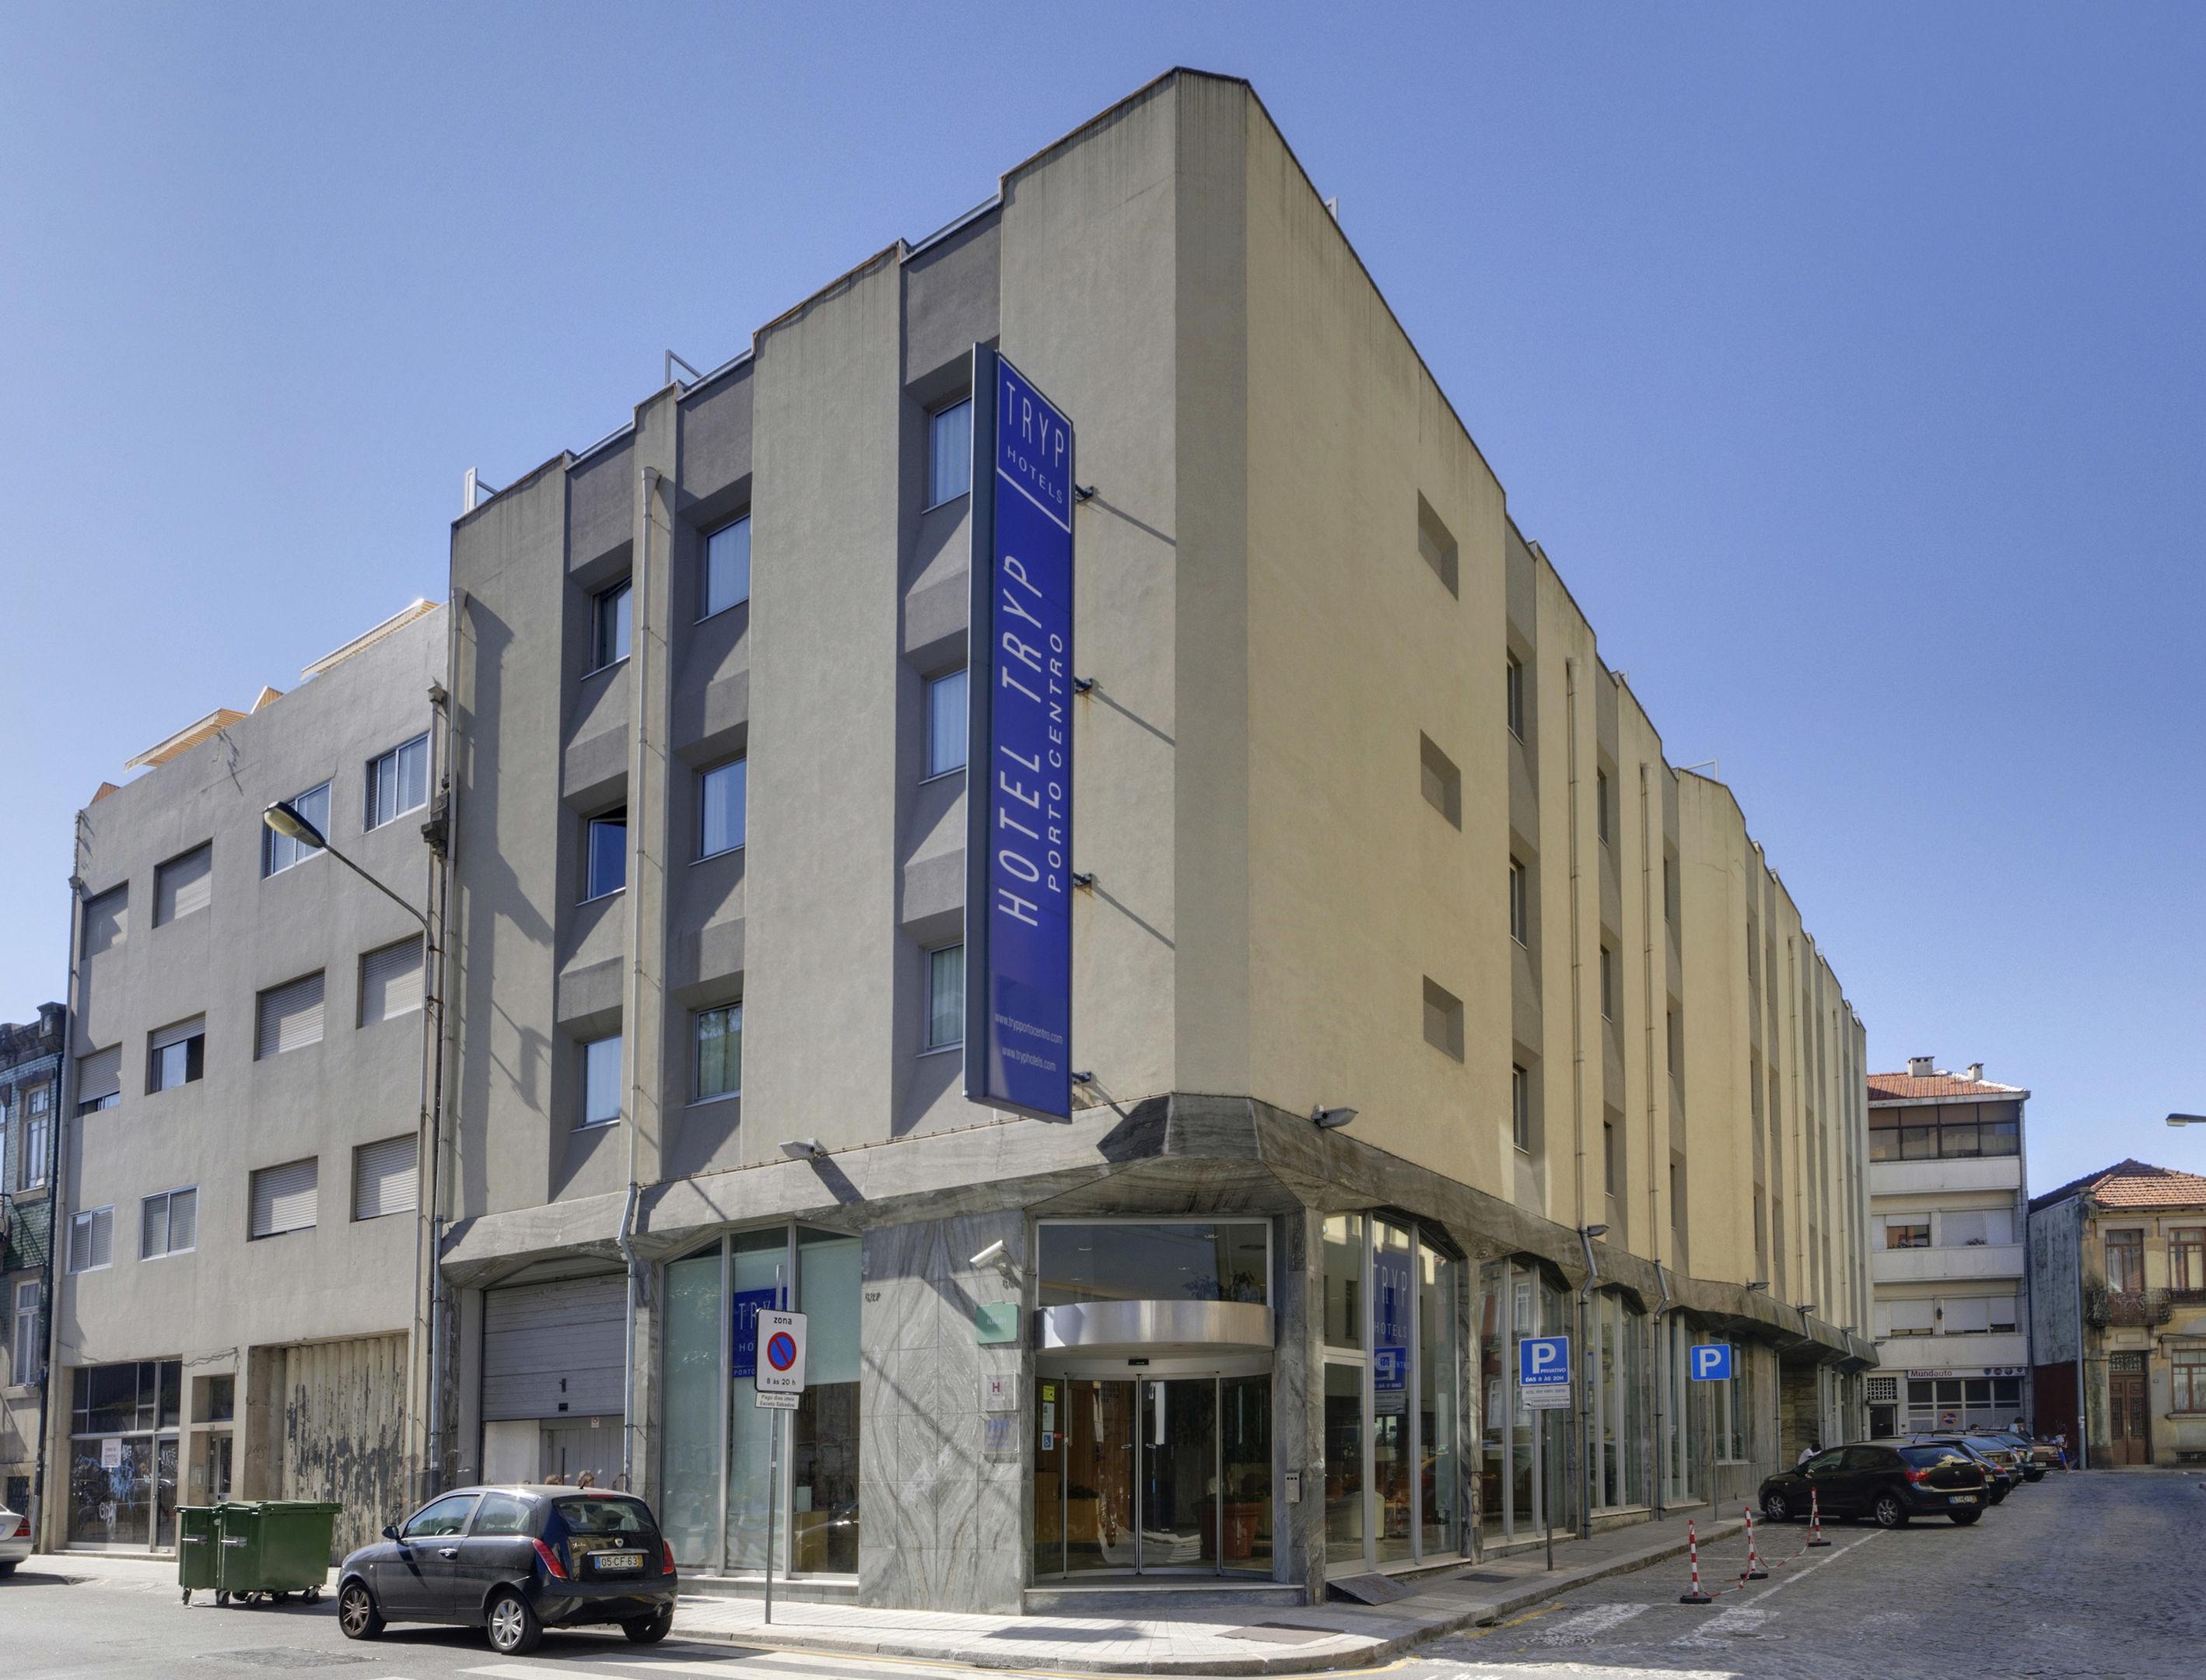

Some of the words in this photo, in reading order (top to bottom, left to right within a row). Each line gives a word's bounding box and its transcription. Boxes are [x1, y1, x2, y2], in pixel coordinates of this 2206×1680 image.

[1006, 380, 1064, 467] TRYP
[1007, 445, 1063, 504] HOTELS
[1002, 555, 1042, 703] TRYP
[1049, 633, 1063, 768] CENTRO
[998, 745, 1040, 927] HOTEL
[1048, 782, 1062, 893] PORTO
[773, 1316, 793, 1326] zona
[992, 1381, 1000, 1392] H
[1532, 1342, 1556, 1374] P
[1700, 1349, 1721, 1377] P
